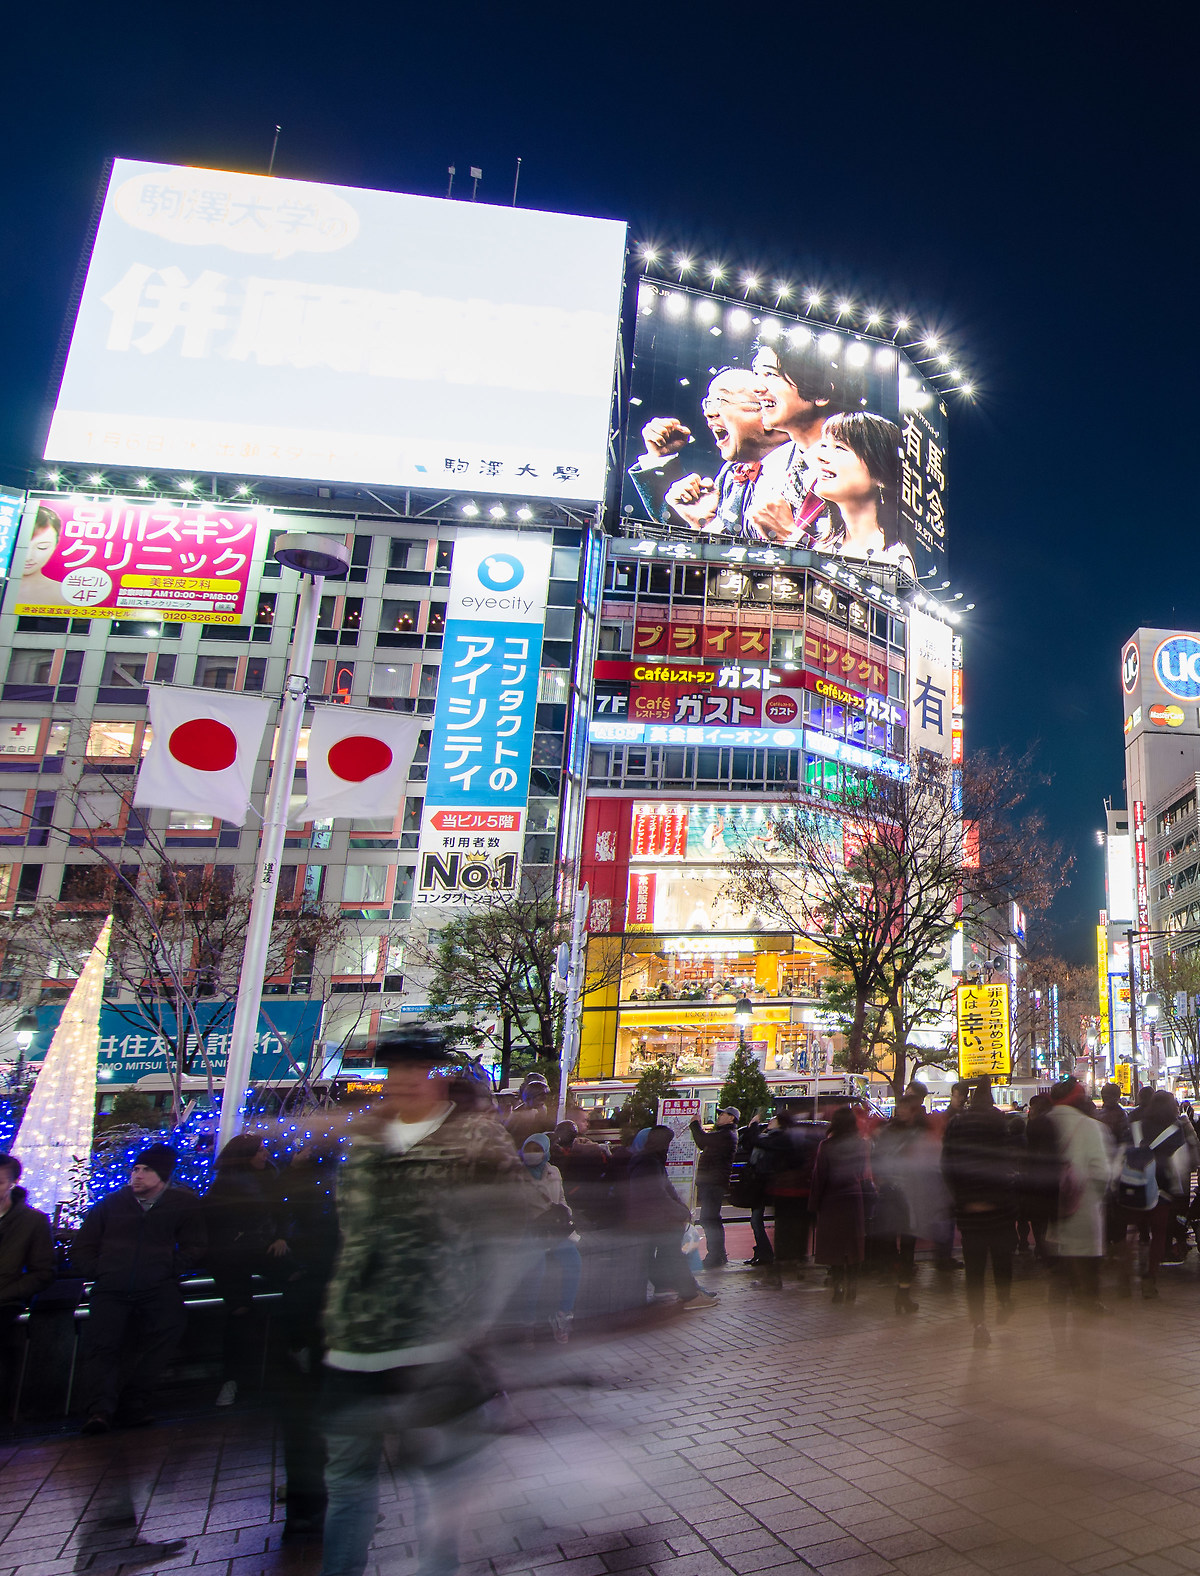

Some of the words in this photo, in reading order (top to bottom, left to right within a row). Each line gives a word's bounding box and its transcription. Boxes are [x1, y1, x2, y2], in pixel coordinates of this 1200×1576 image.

[139, 182, 350, 240] 駒澤大学の
[65, 506, 253, 545] 品川スキン
[61, 539, 247, 577] クリニック
[67, 574, 108, 588] 当ビル
[149, 576, 211, 590] 美容皮フ科
[72, 589, 97, 602] 4F
[119, 599, 192, 609] 品川スキンクリニック
[461, 595, 534, 614] eyecity
[162, 612, 235, 624] 0120-326-500
[637, 625, 768, 653] プライス
[804, 635, 886, 686] コンタクト
[717, 666, 781, 690] ガスト
[444, 635, 495, 791] アイシティ
[488, 637, 529, 792] コンタクトの
[596, 695, 628, 713] 7F
[635, 696, 671, 710] Café
[636, 710, 670, 719] レストラン
[673, 694, 755, 725] ガスト
[768, 707, 795, 717] ガスト
[864, 695, 902, 725] ガスト
[442, 813, 514, 829] 当ビル5階
[443, 836, 500, 849] 利用者数
[420, 851, 517, 892] No.1
[960, 989, 984, 1052] 人は幸い。
[988, 986, 1005, 1070] 罪から清められた
[98, 1031, 287, 1059] 井住友信託行
[96, 1061, 123, 1072] OMO
[125, 1061, 161, 1071] MITSUI
